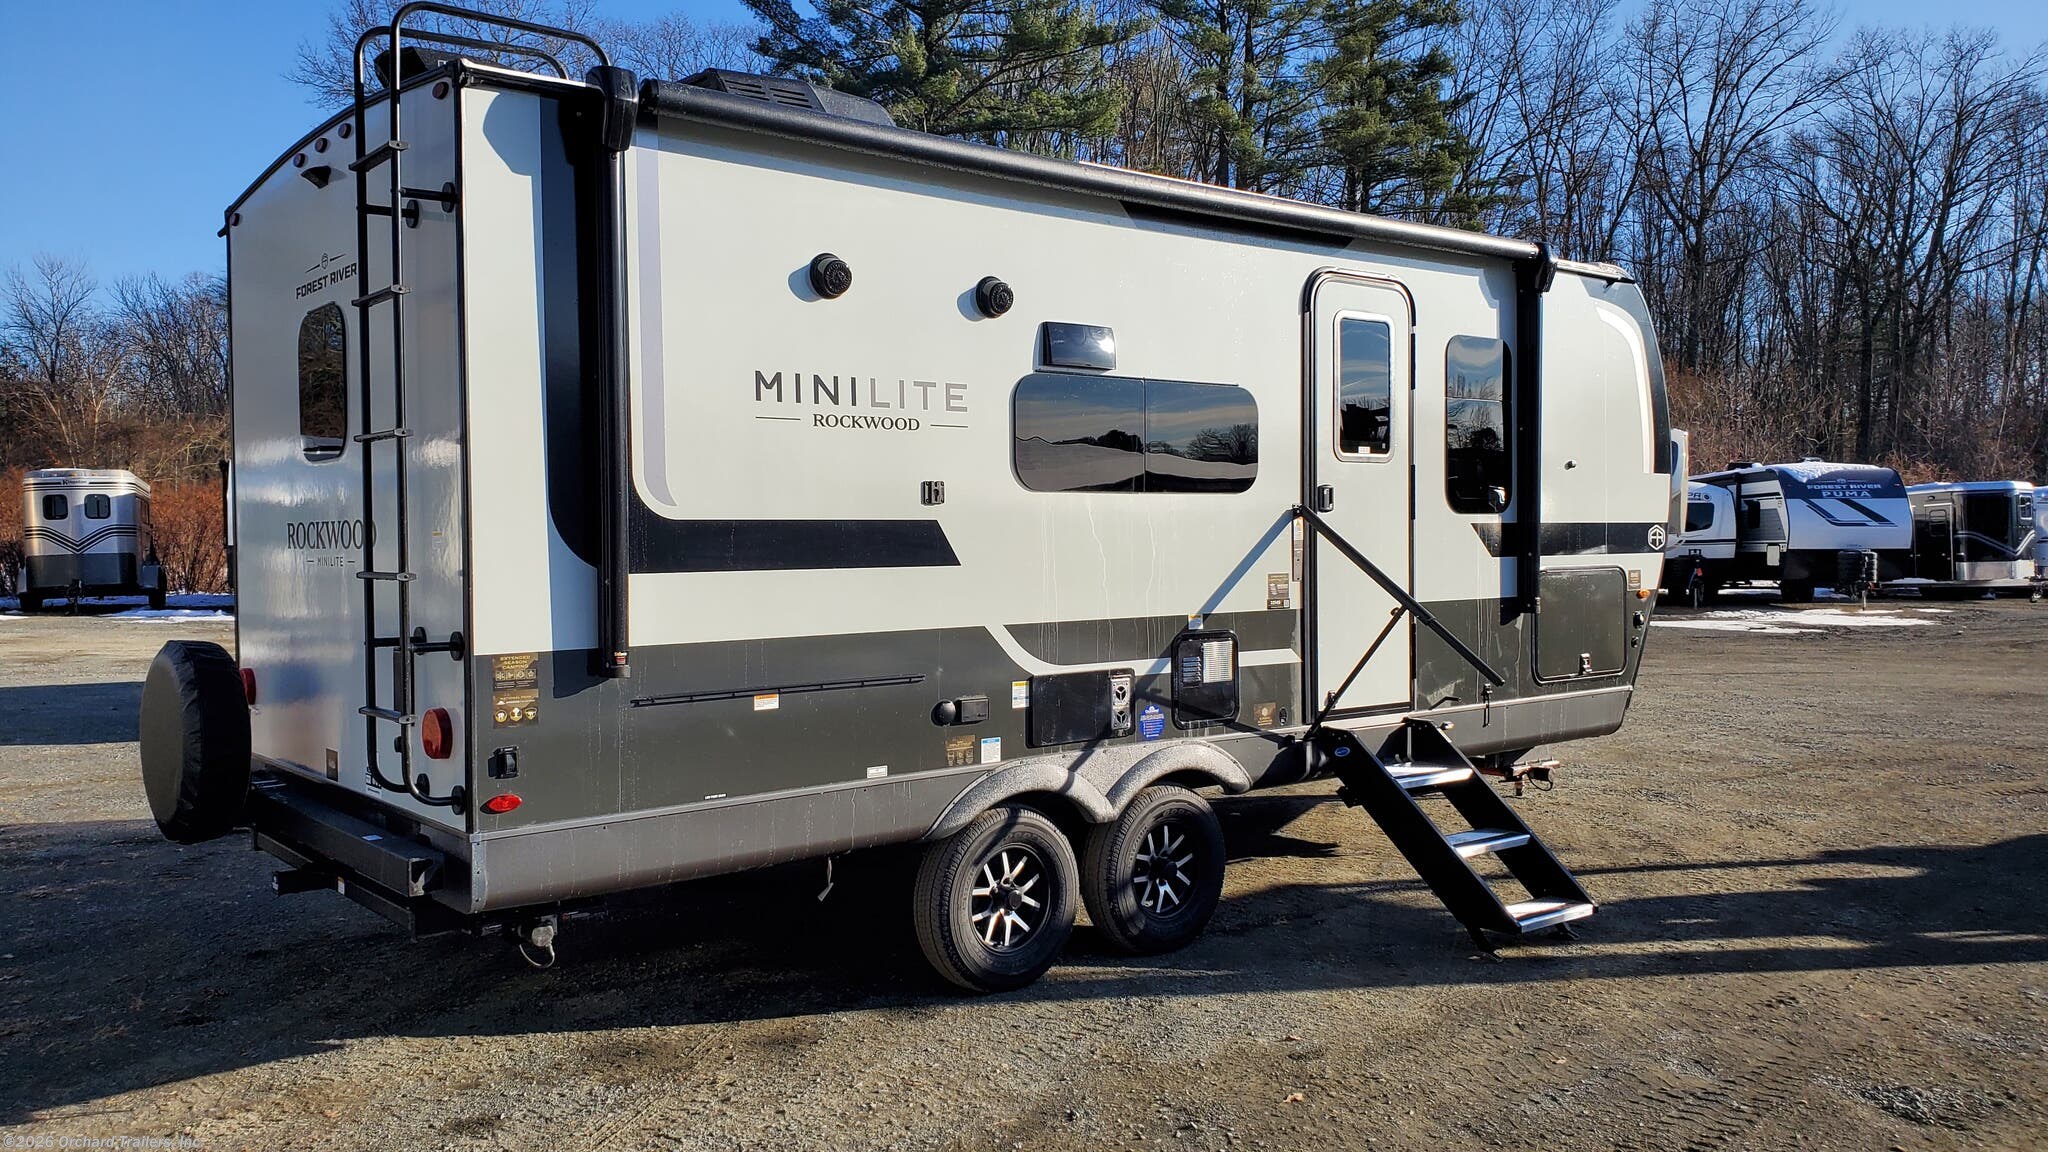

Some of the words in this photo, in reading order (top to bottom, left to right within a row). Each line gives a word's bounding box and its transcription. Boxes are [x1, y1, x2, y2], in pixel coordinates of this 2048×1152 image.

[296, 275, 328, 299] FOREST
[330, 263, 357, 285] RIVER
[754, 370, 968, 412] MINILITE
[812, 413, 920, 431] ROCKWOOD
[317, 556, 344, 567] MINILITE
